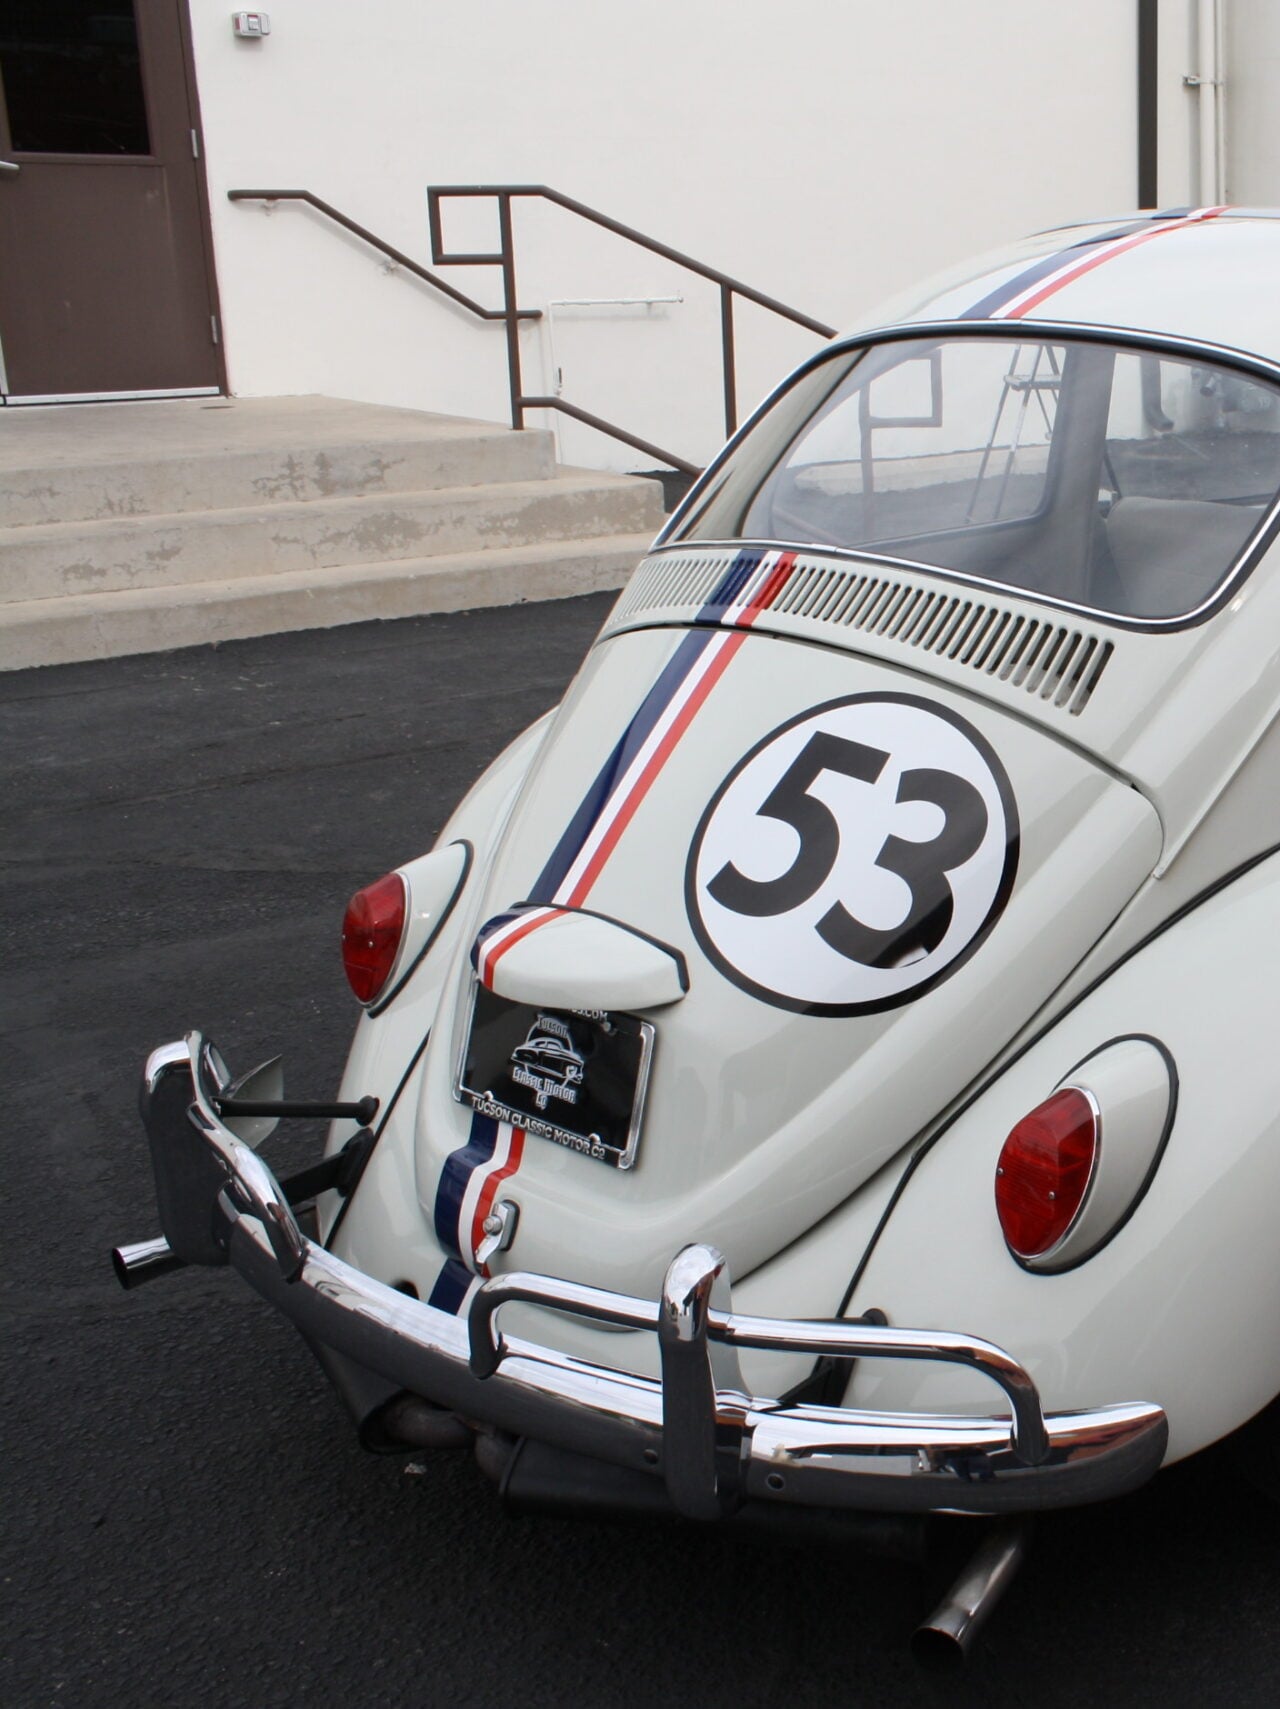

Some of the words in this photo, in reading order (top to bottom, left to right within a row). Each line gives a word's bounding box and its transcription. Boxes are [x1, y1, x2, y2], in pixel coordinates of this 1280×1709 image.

[706, 731, 989, 969] 53
[472, 1096, 511, 1121] TUCSON
[511, 1113, 553, 1138] CLASSIC
[554, 1129, 590, 1155] MOTOR
